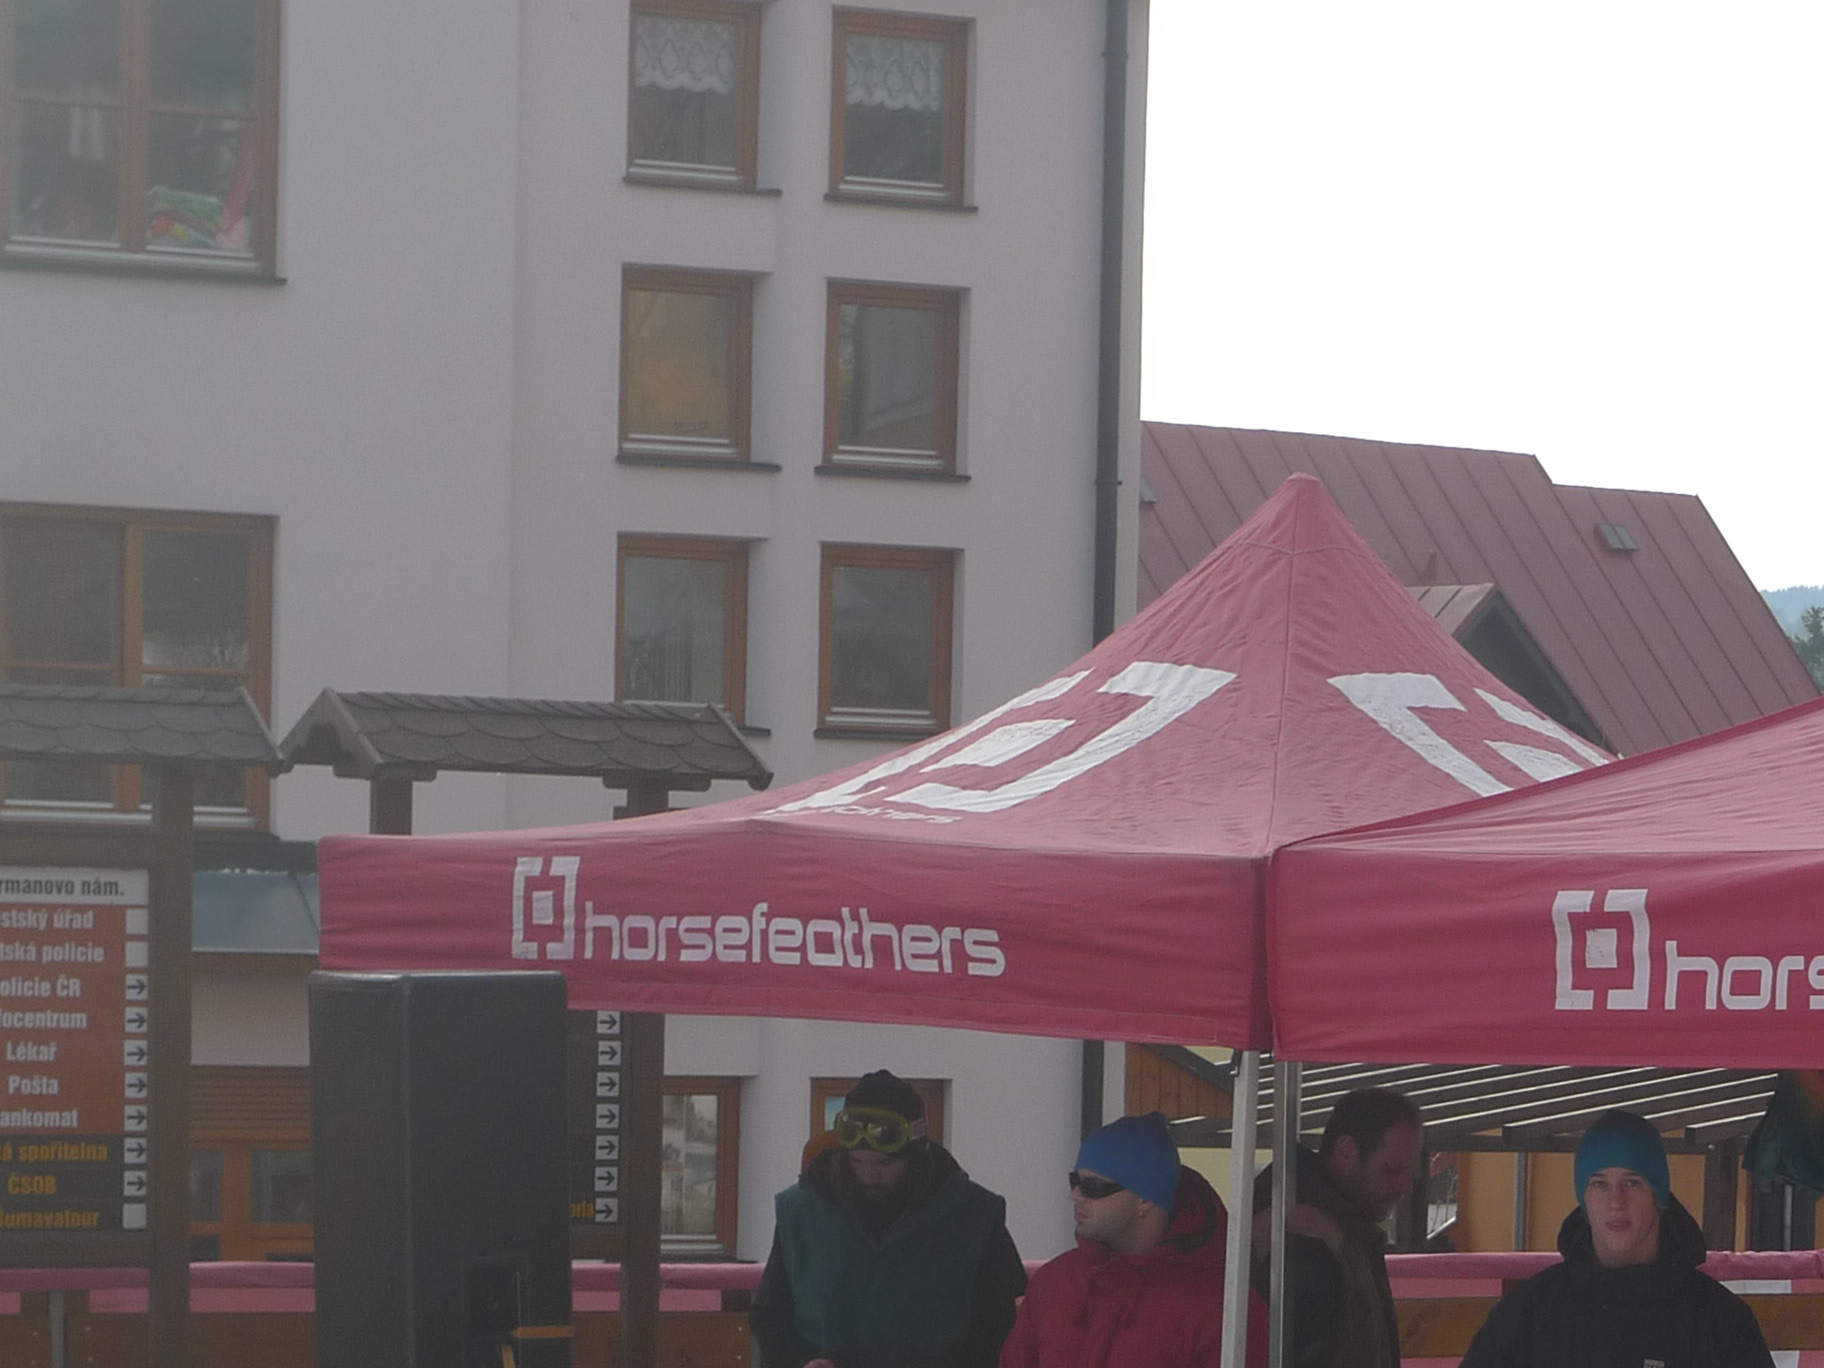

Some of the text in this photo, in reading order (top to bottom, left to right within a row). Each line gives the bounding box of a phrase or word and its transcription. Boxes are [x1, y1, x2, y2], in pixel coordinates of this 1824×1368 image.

[81, 876, 125, 897] nám.
[53, 908, 94, 929] úřad
[584, 900, 1006, 977] horsefeathers
[42, 941, 105, 964] policie
[56, 974, 81, 998] ČR
[6, 1041, 58, 1062] Lékař
[8, 1074, 59, 1095] Pošta
[18, 1141, 109, 1163] spořitelna
[7, 1172, 57, 1195] ČSOB
